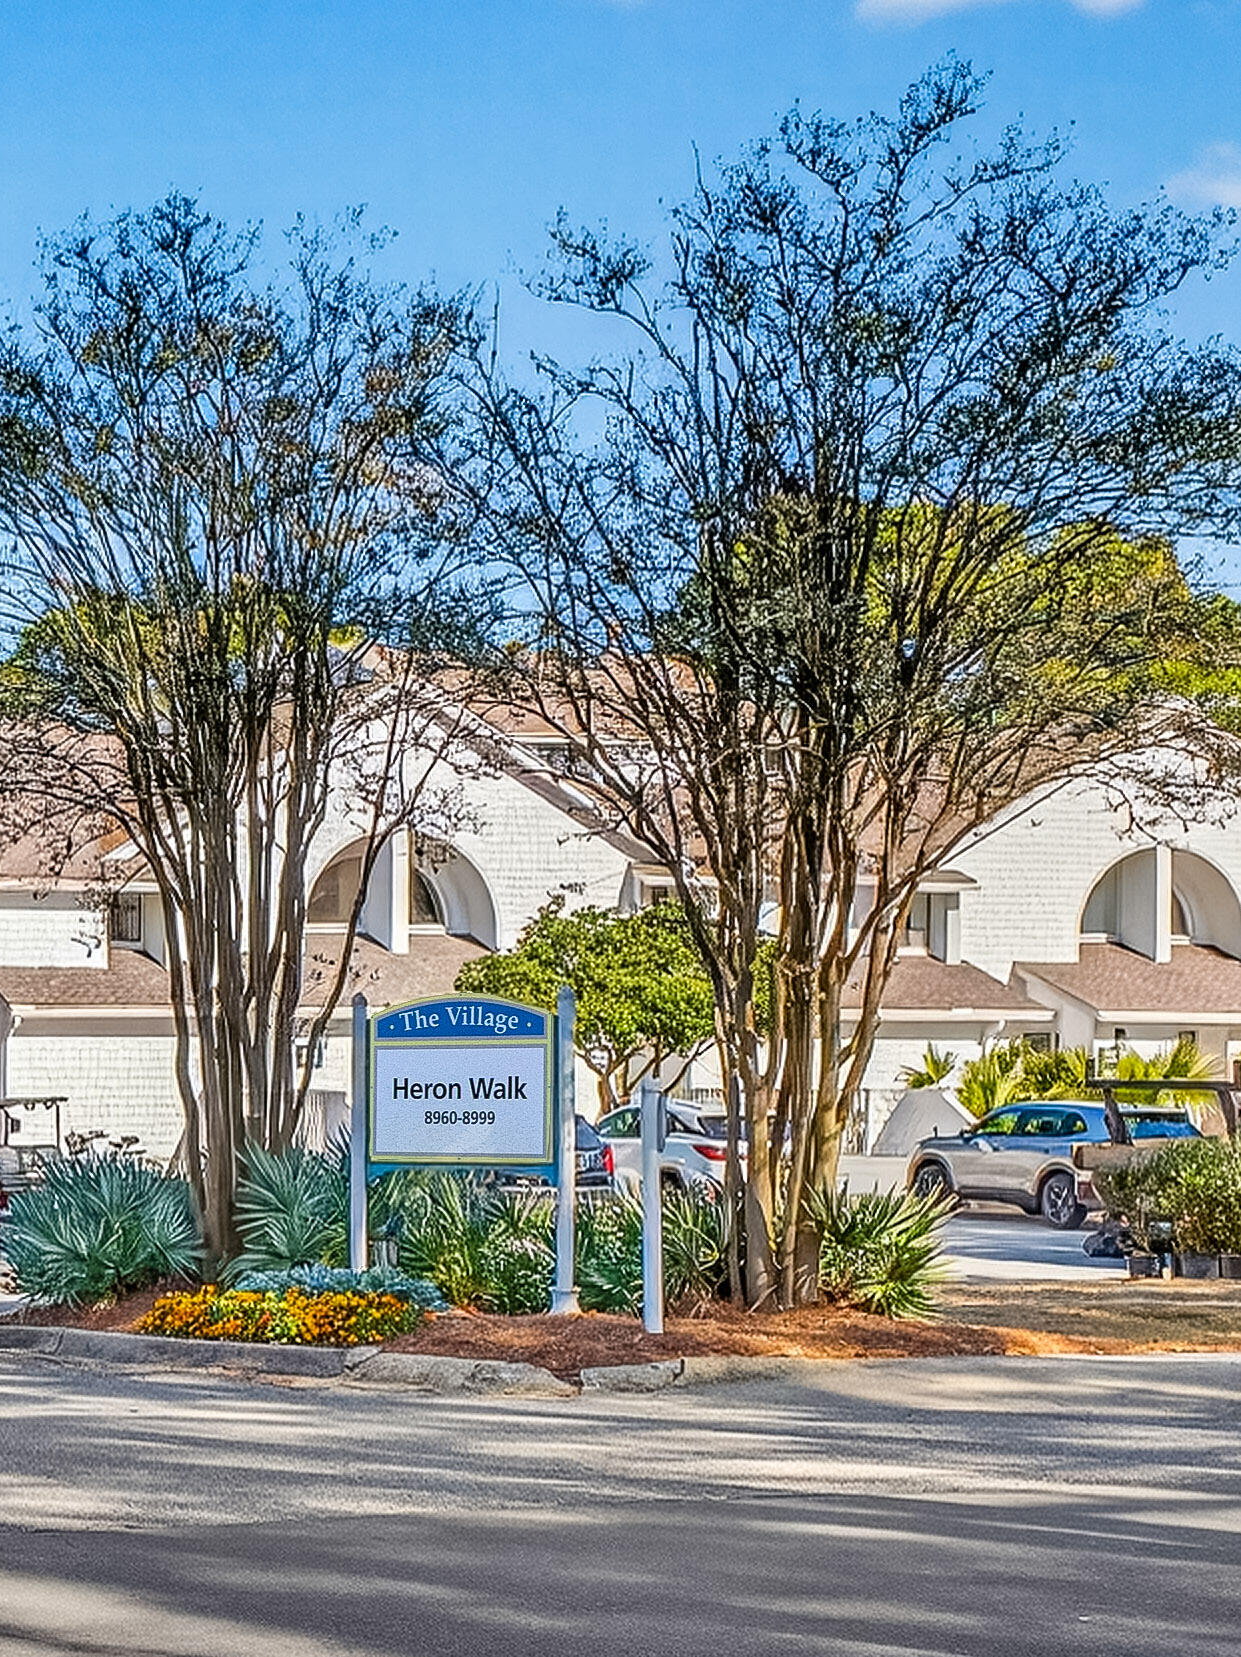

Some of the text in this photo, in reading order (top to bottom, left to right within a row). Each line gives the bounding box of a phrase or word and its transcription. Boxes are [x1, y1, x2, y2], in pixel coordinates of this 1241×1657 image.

[398, 1006, 519, 1034] The Village
[392, 1075, 528, 1100] Heron Walk
[424, 1110, 496, 1125] 8960-8999
